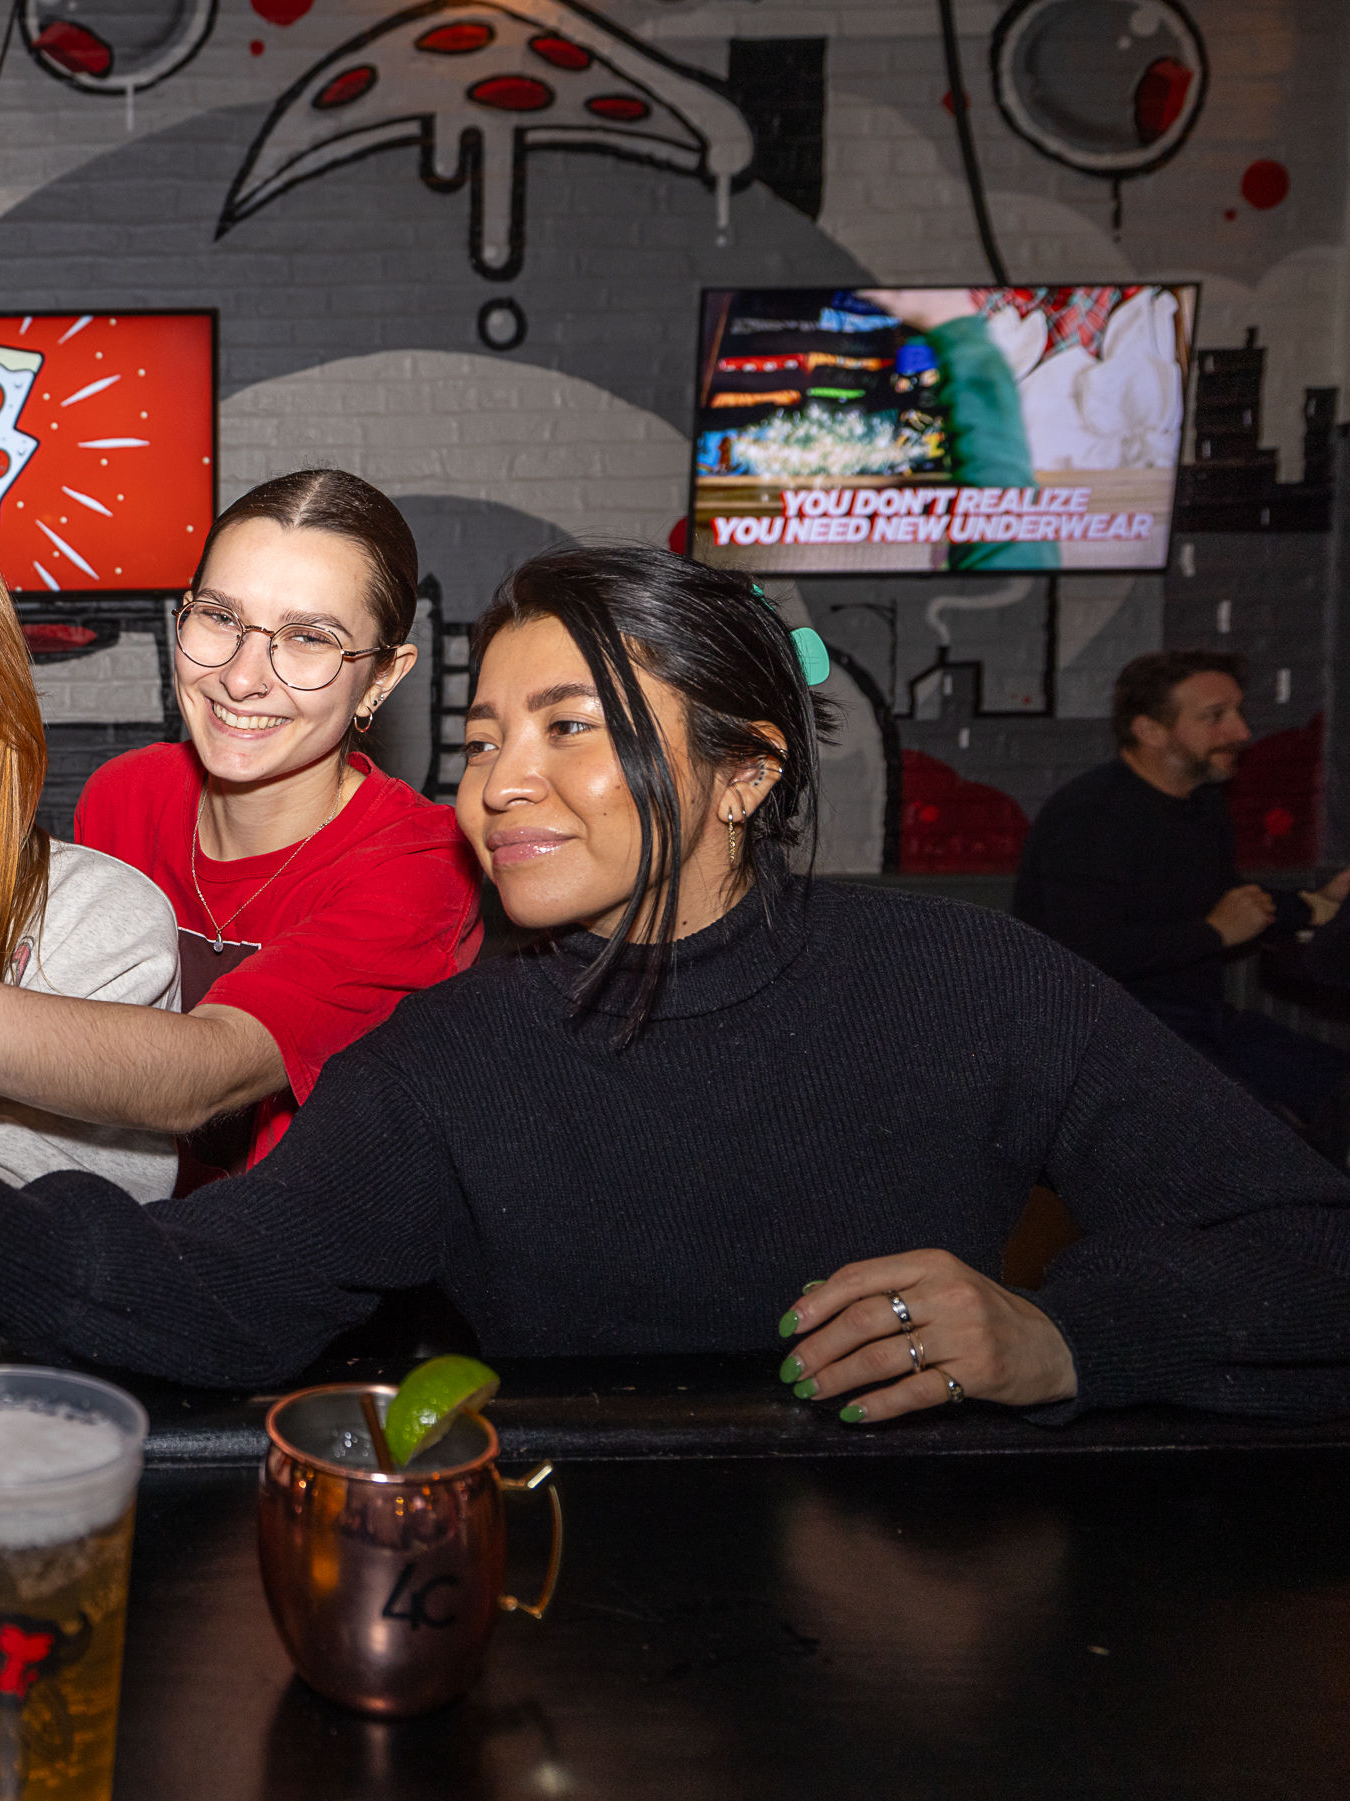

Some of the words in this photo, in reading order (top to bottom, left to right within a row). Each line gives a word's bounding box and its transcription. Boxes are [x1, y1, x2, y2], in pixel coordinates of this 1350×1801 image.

[780, 489, 854, 517] YOU
[851, 487, 957, 517] DON'T
[953, 486, 1092, 514] REALIZE
[710, 516, 784, 545] YOU
[783, 516, 871, 545] NEED
[870, 515, 950, 544] NEW
[948, 513, 1153, 544] UNDERWEAR
[381, 1562, 457, 1630] 4C
